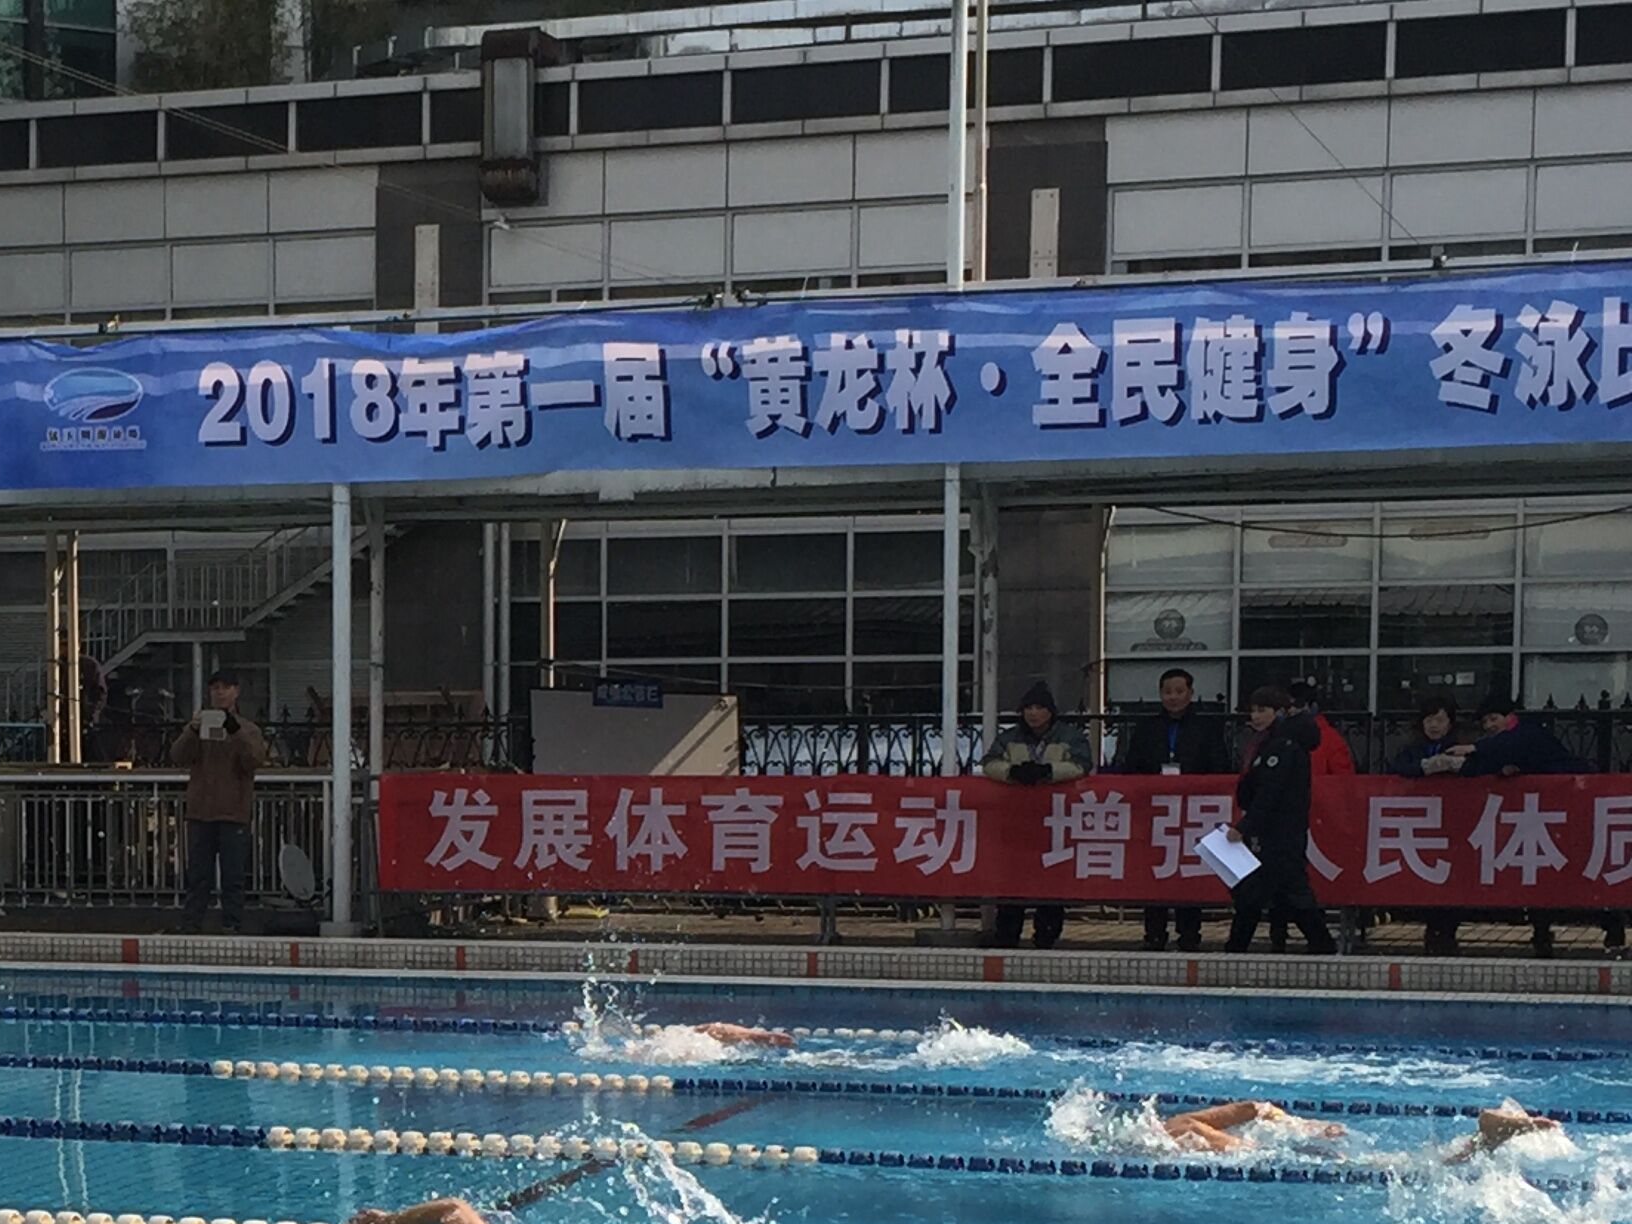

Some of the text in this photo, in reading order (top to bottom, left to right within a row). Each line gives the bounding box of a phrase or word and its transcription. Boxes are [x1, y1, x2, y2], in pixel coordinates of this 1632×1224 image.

[424, 788, 1632, 887] 发展体育运动 增强民体质
